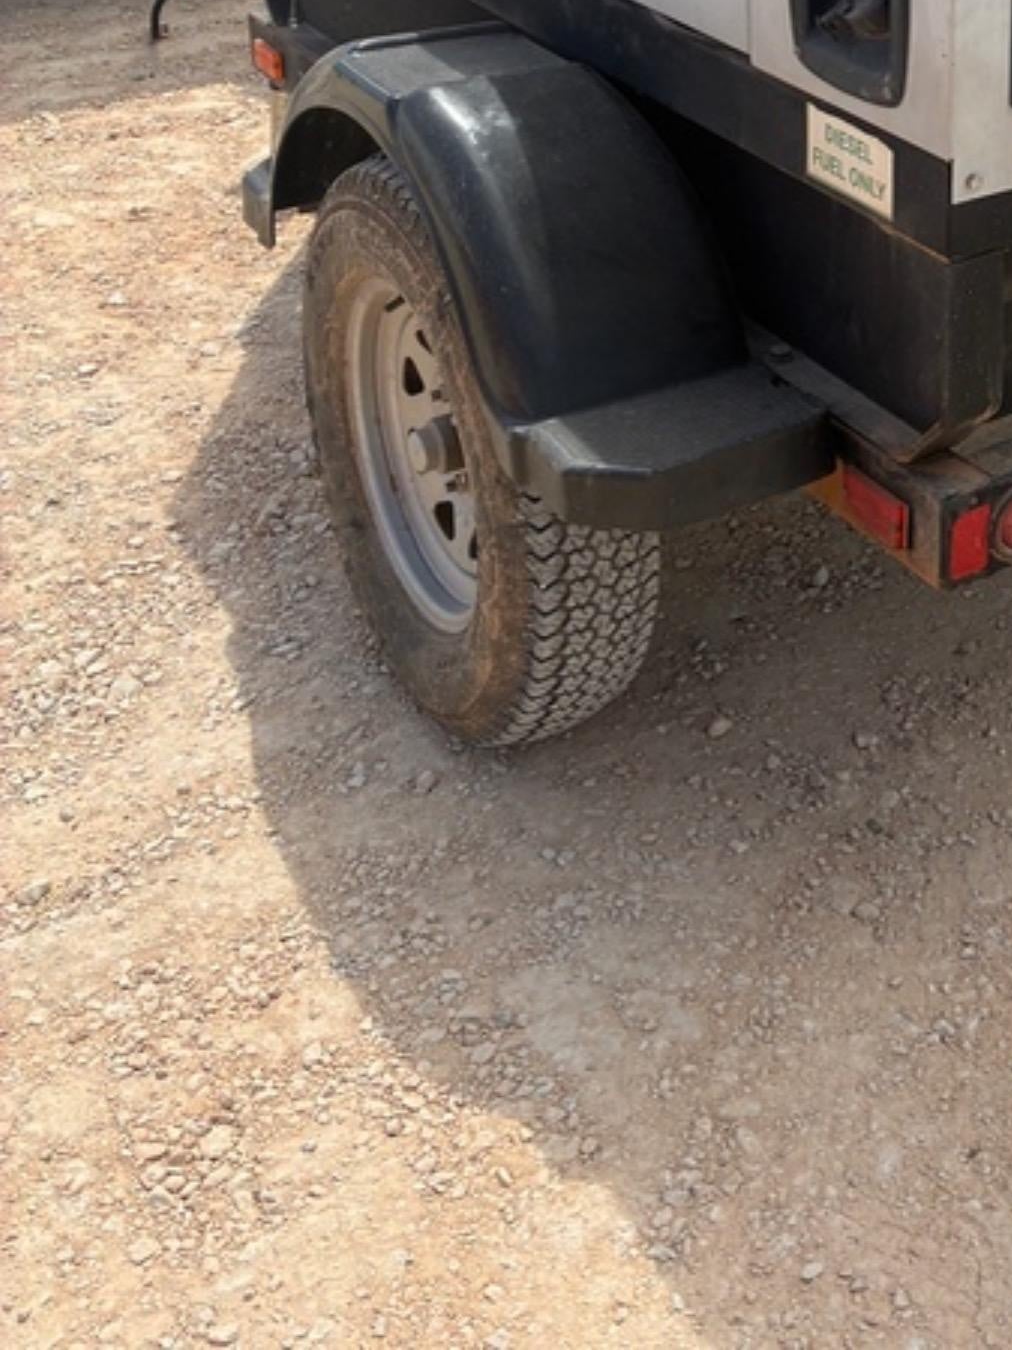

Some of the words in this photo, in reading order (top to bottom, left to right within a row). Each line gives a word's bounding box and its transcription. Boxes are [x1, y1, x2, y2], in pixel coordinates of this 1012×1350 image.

[825, 122, 873, 166] DIESEL
[812, 145, 846, 181] FUEL
[849, 166, 886, 201] ONLY
